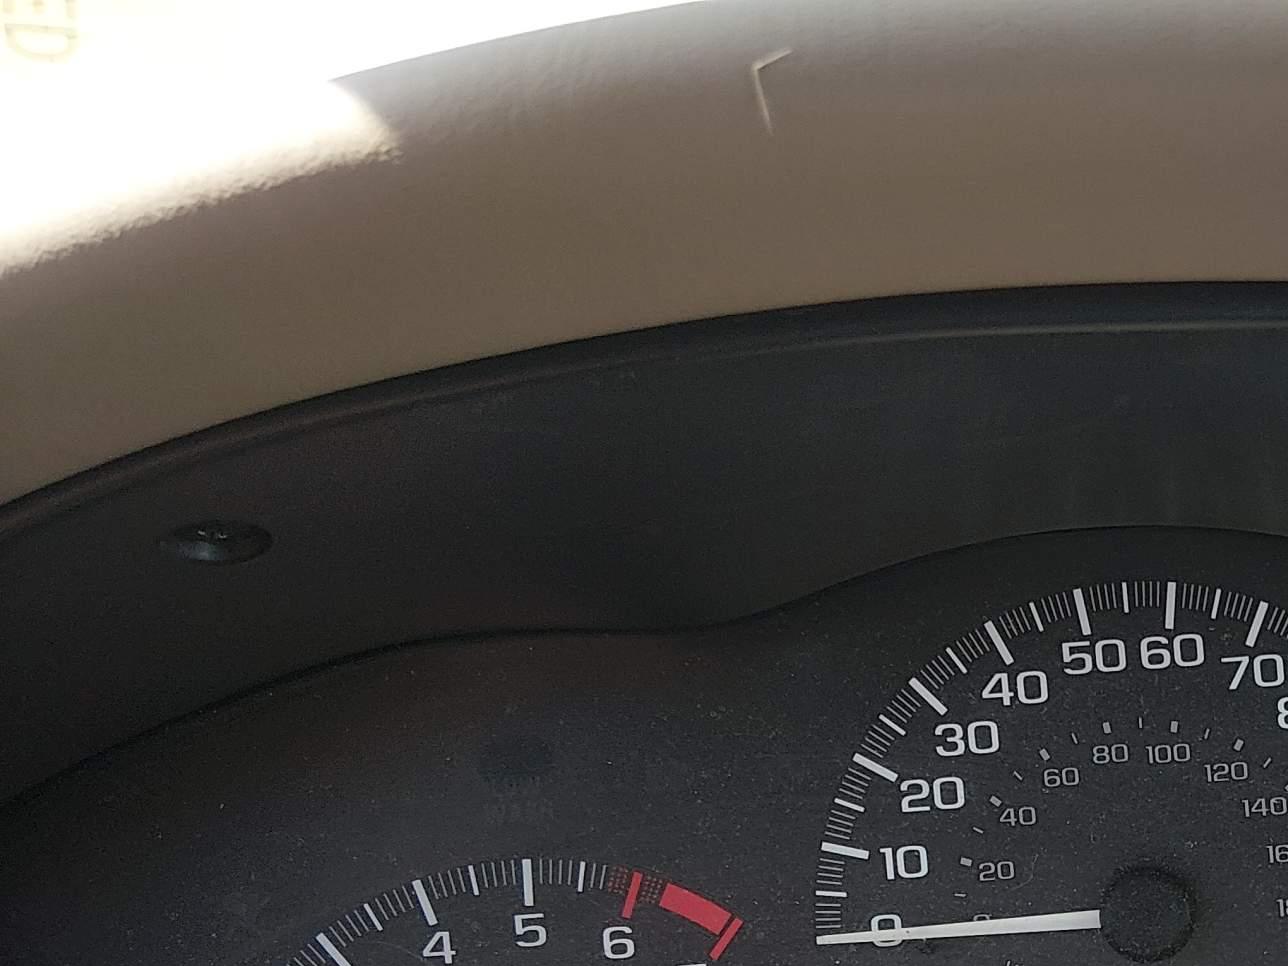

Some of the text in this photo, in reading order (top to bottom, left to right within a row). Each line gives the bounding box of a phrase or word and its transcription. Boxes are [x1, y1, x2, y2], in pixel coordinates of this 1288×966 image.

[1062, 640, 1126, 674] 50
[1141, 634, 1204, 669] 60
[1221, 655, 1284, 689] 70
[982, 671, 1048, 705] 40
[935, 721, 999, 756] 30
[1093, 744, 1128, 763] 80
[1146, 744, 1190, 763] 100
[1044, 768, 1079, 787] 60
[1205, 762, 1247, 782] 120
[901, 775, 964, 812] 20
[1242, 797, 1287, 817] 140
[999, 806, 1036, 826] 40
[880, 846, 928, 879] 10
[979, 862, 1014, 881] 20
[514, 914, 546, 946] 5
[603, 927, 634, 958] 6
[871, 914, 902, 947] 0
[423, 932, 456, 963] 4
